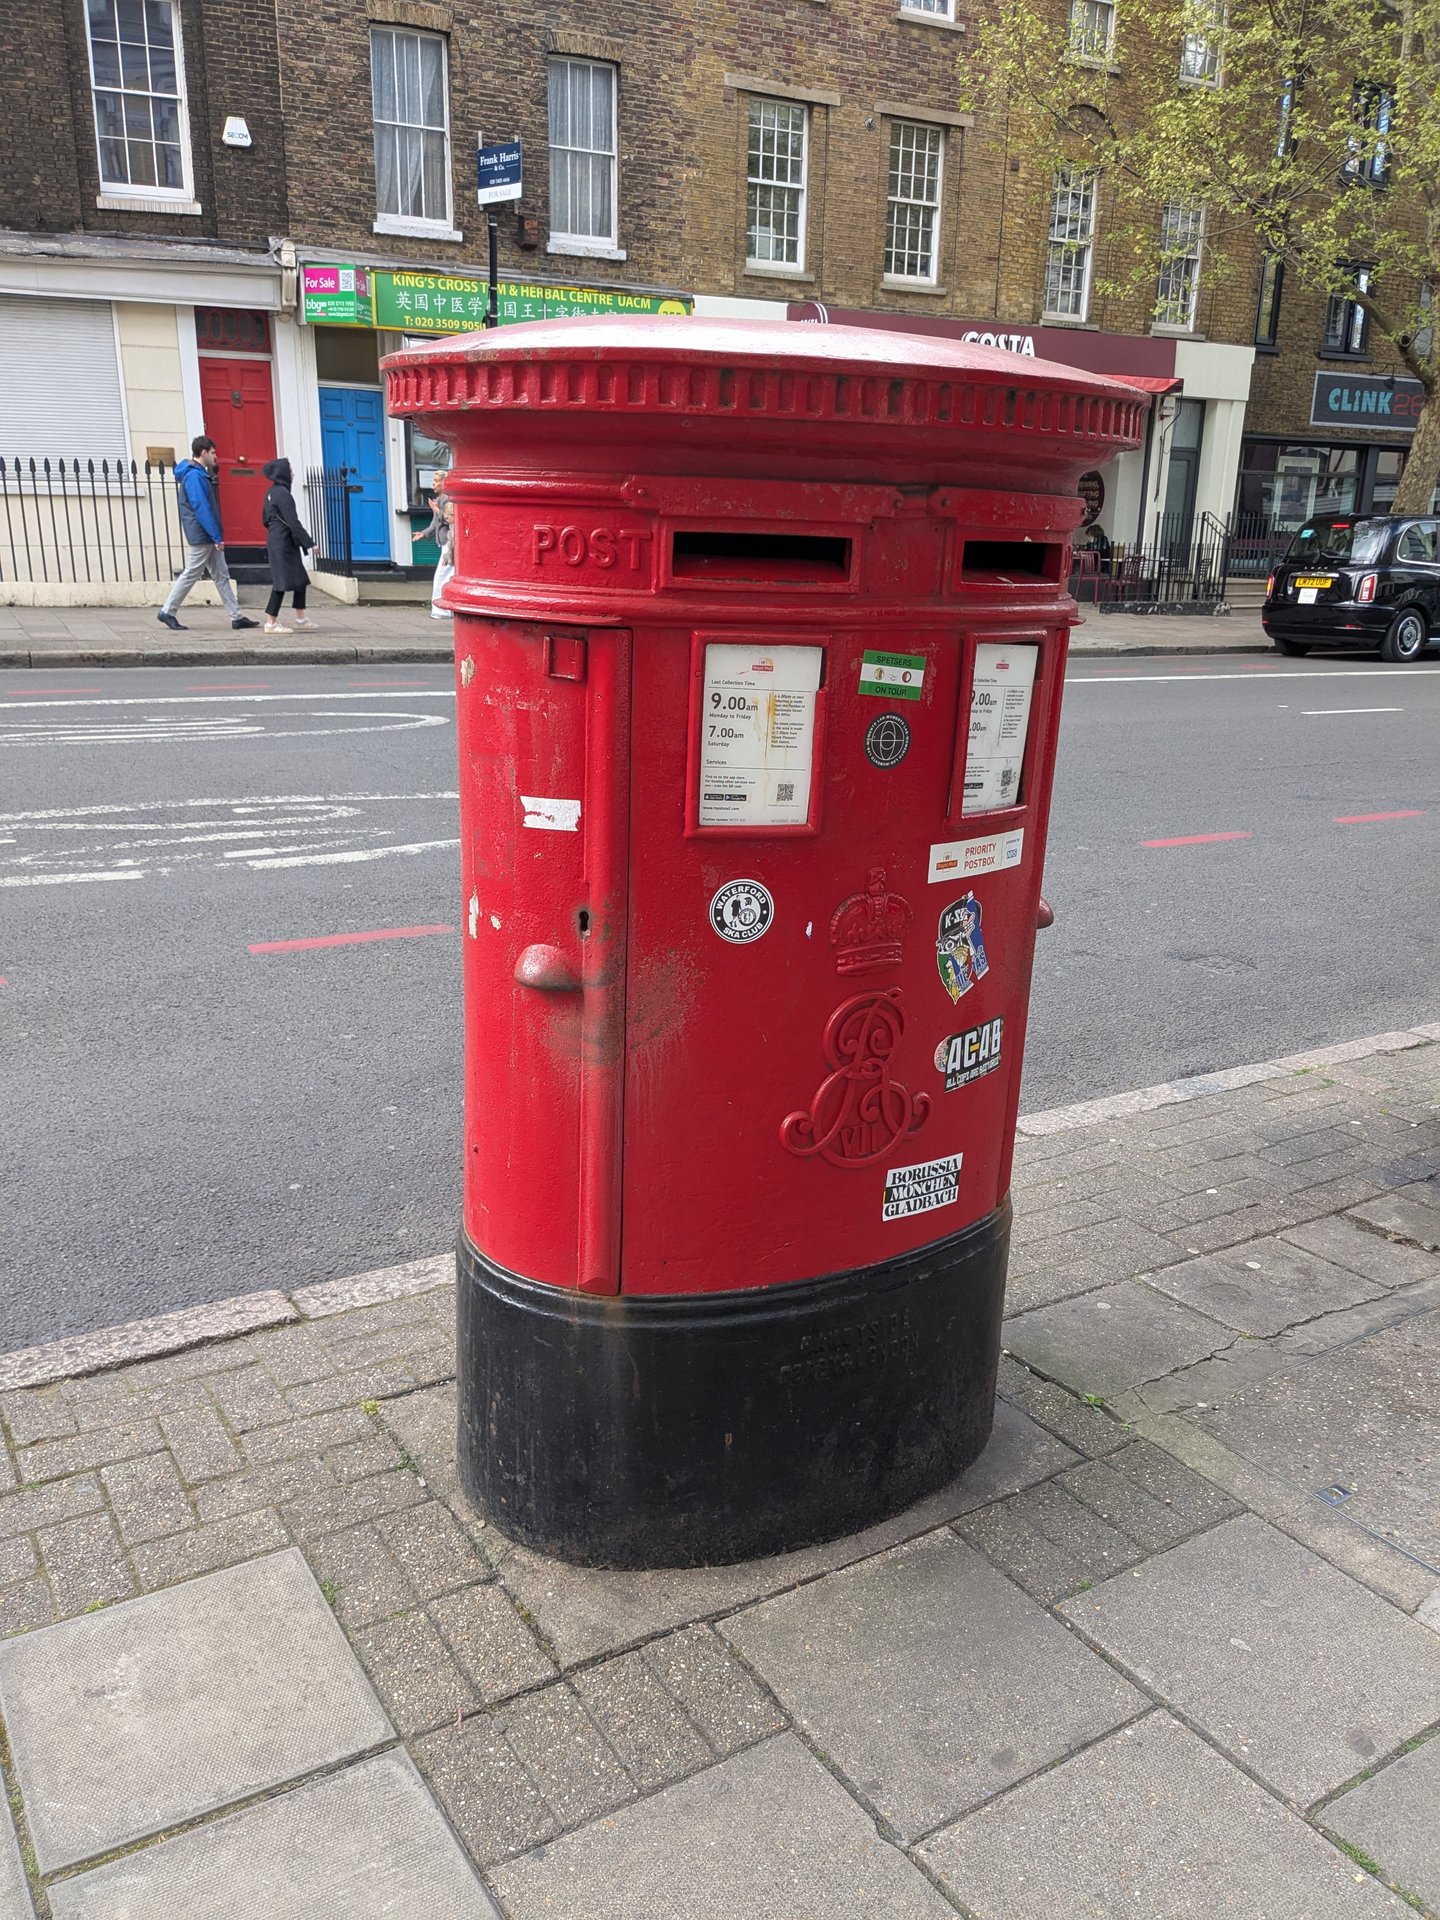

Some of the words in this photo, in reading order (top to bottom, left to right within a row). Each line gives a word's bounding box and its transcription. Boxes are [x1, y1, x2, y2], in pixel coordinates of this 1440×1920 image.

[480, 154, 498, 166] Frank
[500, 151, 519, 162] Harris
[489, 191, 498, 199] FOR
[500, 189, 511, 197] SALE
[305, 278, 318, 288] For
[320, 277, 335, 288] Sale
[393, 274, 435, 289] KING'S
[438, 278, 478, 293] CROSS
[480, 282, 506, 295] TM
[510, 285, 517, 296] &
[521, 286, 566, 301] HERBAL
[570, 291, 612, 305] CENTRE
[618, 296, 650, 309] UACM
[404, 316, 413, 325] T:
[415, 318, 433, 328] 020
[436, 319, 459, 329] 3509
[534, 524, 653, 570] POST
[876, 656, 912, 666] SPETSERS
[875, 686, 888, 694] ON
[889, 687, 907, 696] TOUR
[711, 692, 758, 711] 9.00am
[709, 725, 744, 738] 7.00am
[970, 722, 986, 731] .00am
[965, 843, 997, 857] PRIORITY
[964, 856, 995, 870] POSTBOX
[716, 886, 766, 910] WATERFORD
[723, 927, 740, 938] SKA
[741, 922, 763, 938] CLUB
[947, 1018, 1001, 1074] ACAB
[946, 1078, 956, 1088] ALL
[957, 1071, 970, 1084] COPS
[970, 1067, 979, 1079] ARE
[891, 1158, 958, 1185] BORUSSIA
[884, 1188, 957, 1217] GLADBACH
